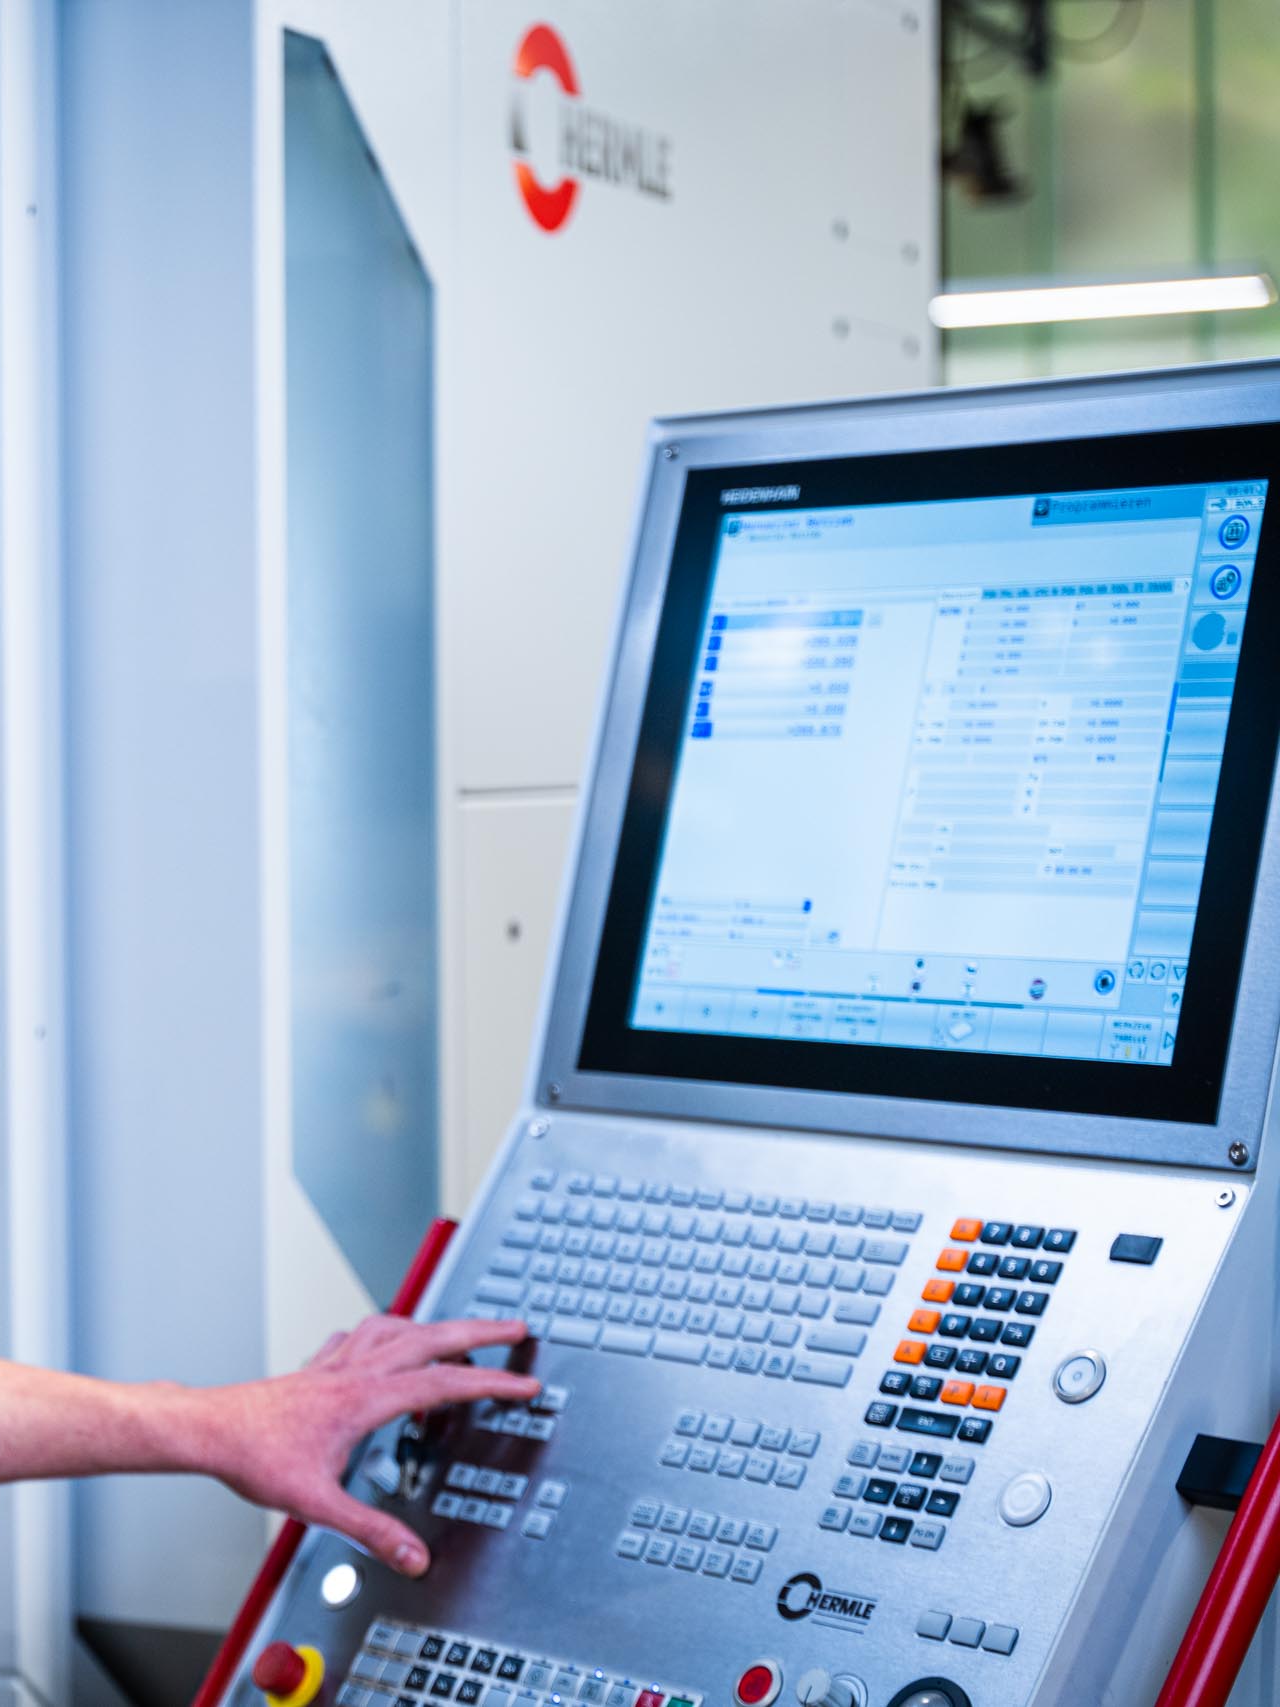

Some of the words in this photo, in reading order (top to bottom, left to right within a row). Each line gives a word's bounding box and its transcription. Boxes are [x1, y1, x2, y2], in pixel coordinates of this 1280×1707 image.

[989, 1225, 1001, 1238] 7
[1020, 1229, 1031, 1242] 8
[1052, 1232, 1063, 1245] 9
[975, 1255, 986, 1268] 4
[1007, 1259, 1017, 1273] 5
[1037, 1263, 1049, 1277] 6
[991, 1291, 1002, 1304] 2
[1024, 1294, 1035, 1308] 3
[806, 1591, 876, 1621] HERMLE
